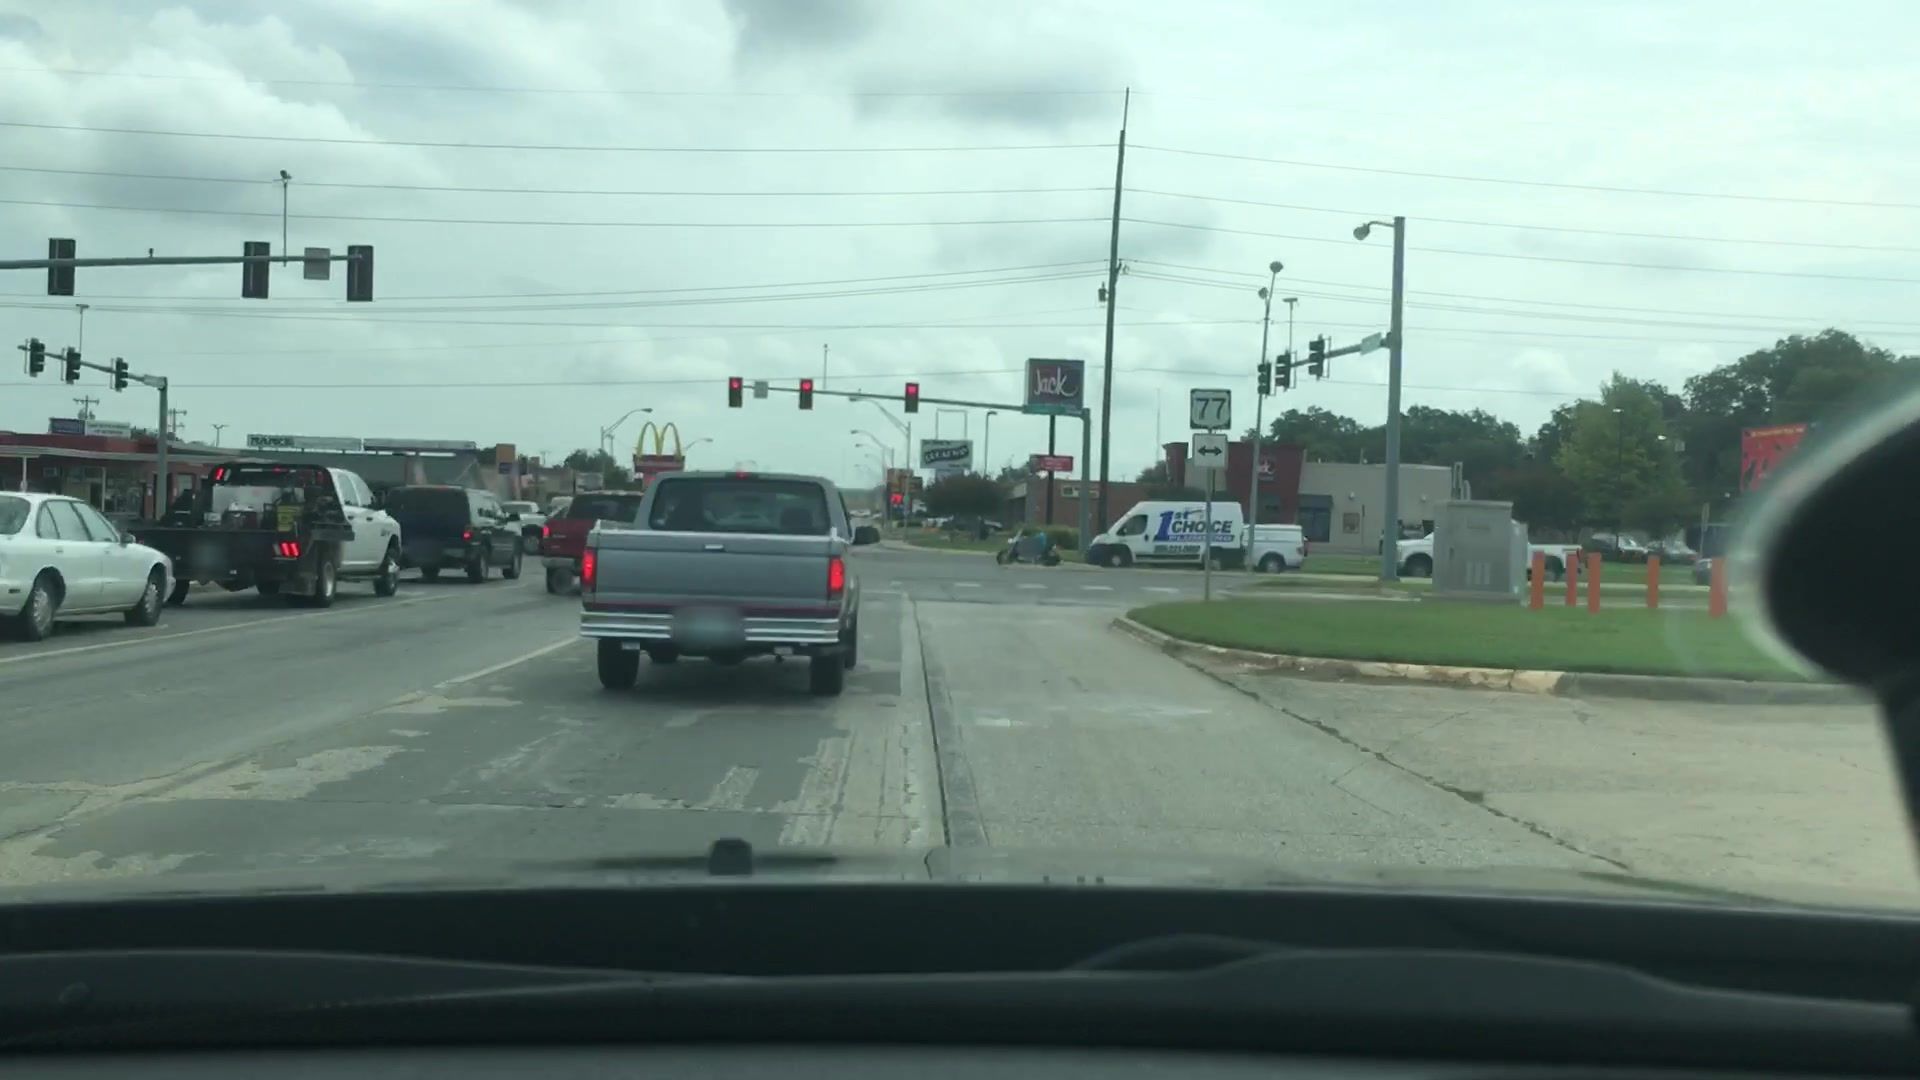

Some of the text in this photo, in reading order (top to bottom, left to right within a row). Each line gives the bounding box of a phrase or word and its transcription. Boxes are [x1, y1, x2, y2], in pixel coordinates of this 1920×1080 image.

[1034, 365, 1077, 397] Jack
[1196, 398, 1226, 420] 77
[1172, 520, 1233, 533] CHOCE
